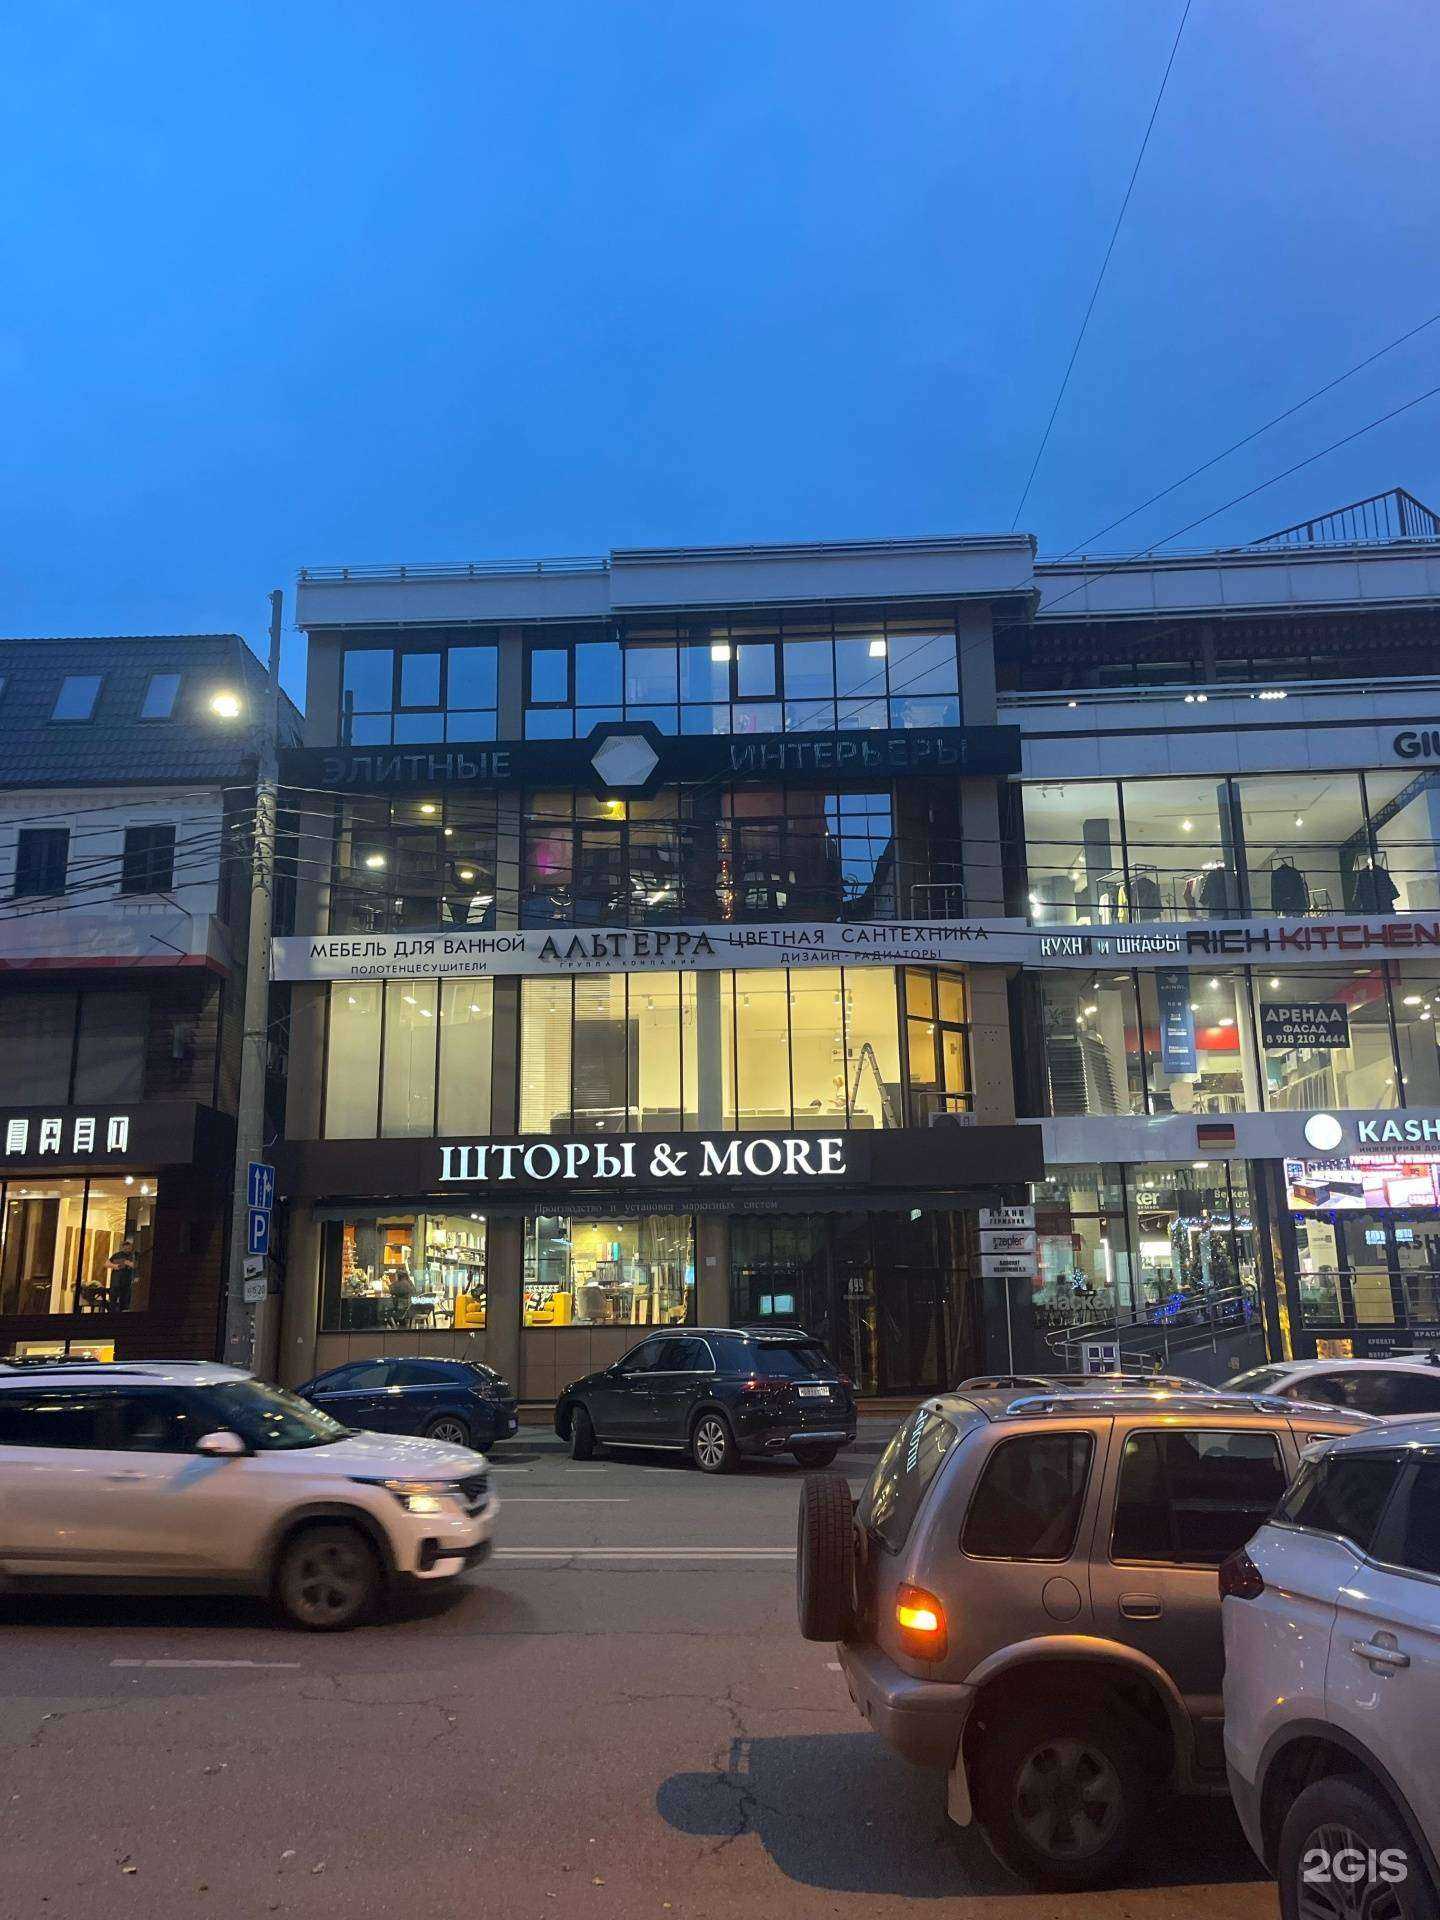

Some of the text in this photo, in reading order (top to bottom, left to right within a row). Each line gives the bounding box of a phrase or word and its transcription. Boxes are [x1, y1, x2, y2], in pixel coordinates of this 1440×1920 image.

[322, 737, 968, 784] ЭЛИТНЫЕ ИНТЕРЬЕРЫ
[310, 932, 525, 958] МЕБЕЛЬ ДЛЯ ВАННОЙ
[538, 931, 716, 959] АЛЬТЕРРА
[729, 925, 989, 948] ЦВЕТНАЯ САНТЕХНИКА
[1116, 935, 1181, 954] ШКАФЫ
[1187, 922, 1440, 954] RICH KITCHEN
[350, 962, 487, 975] ПОЛОТЕНЦЕСУШИТЕЛИ
[1266, 1008, 1342, 1023] АРЕНДА
[1266, 1034, 1346, 1043] 8 918 210 4444
[1283, 1024, 1327, 1034] ФАСАД
[1358, 1118, 1440, 1142] KASH
[438, 1138, 847, 1181] ШТОРЫ & MORE
[254, 1216, 266, 1248] P
